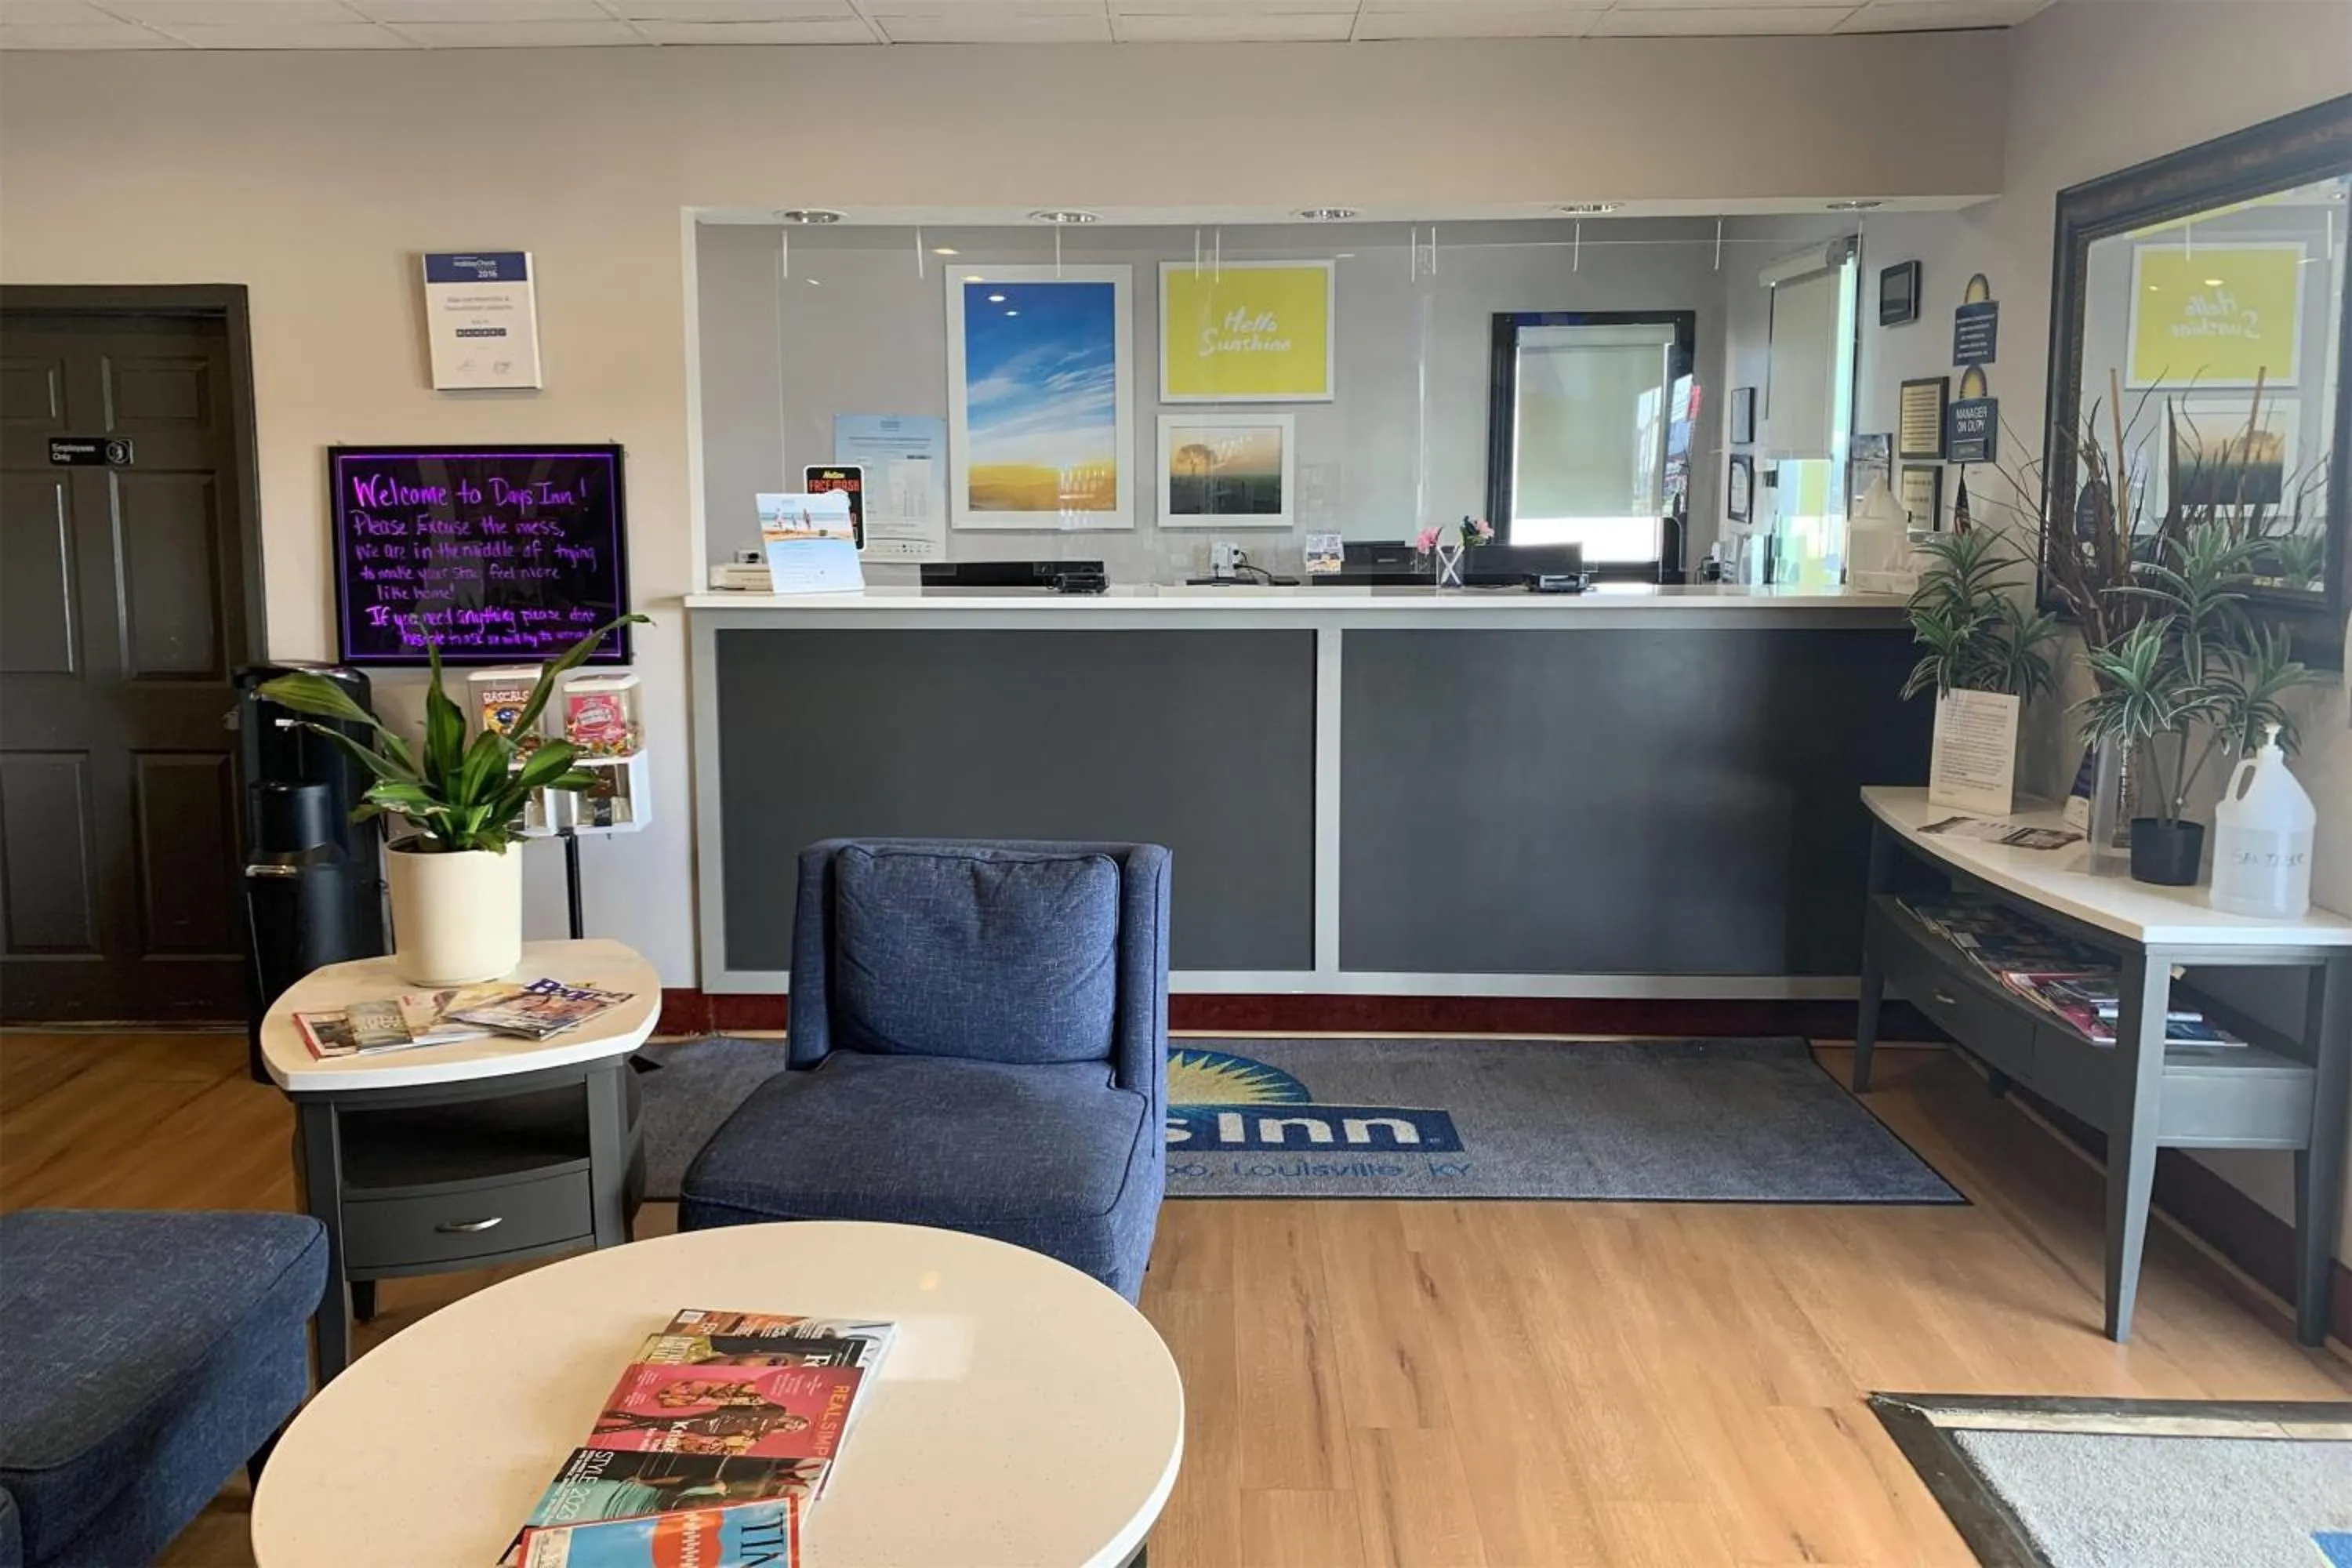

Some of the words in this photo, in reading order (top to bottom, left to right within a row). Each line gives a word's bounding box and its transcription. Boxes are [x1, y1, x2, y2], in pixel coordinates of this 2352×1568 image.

[1223, 306, 1278, 333] Hello
[1200, 327, 1292, 358] Sunshine
[1955, 406, 1987, 420] MANAGER
[353, 474, 448, 508] Welcome
[455, 478, 481, 504] to
[488, 477, 534, 515] Days
[349, 510, 408, 536] Please
[479, 515, 510, 535] the
[413, 542, 434, 559] in
[521, 566, 562, 579] more
[364, 605, 391, 626] If
[1218, 1112, 1421, 1145] Inn
[1427, 1162, 1472, 1178] KY
[820, 1384, 853, 1422] REAL
[577, 1450, 615, 1486] STYLE
[554, 1486, 592, 1521] 2023
